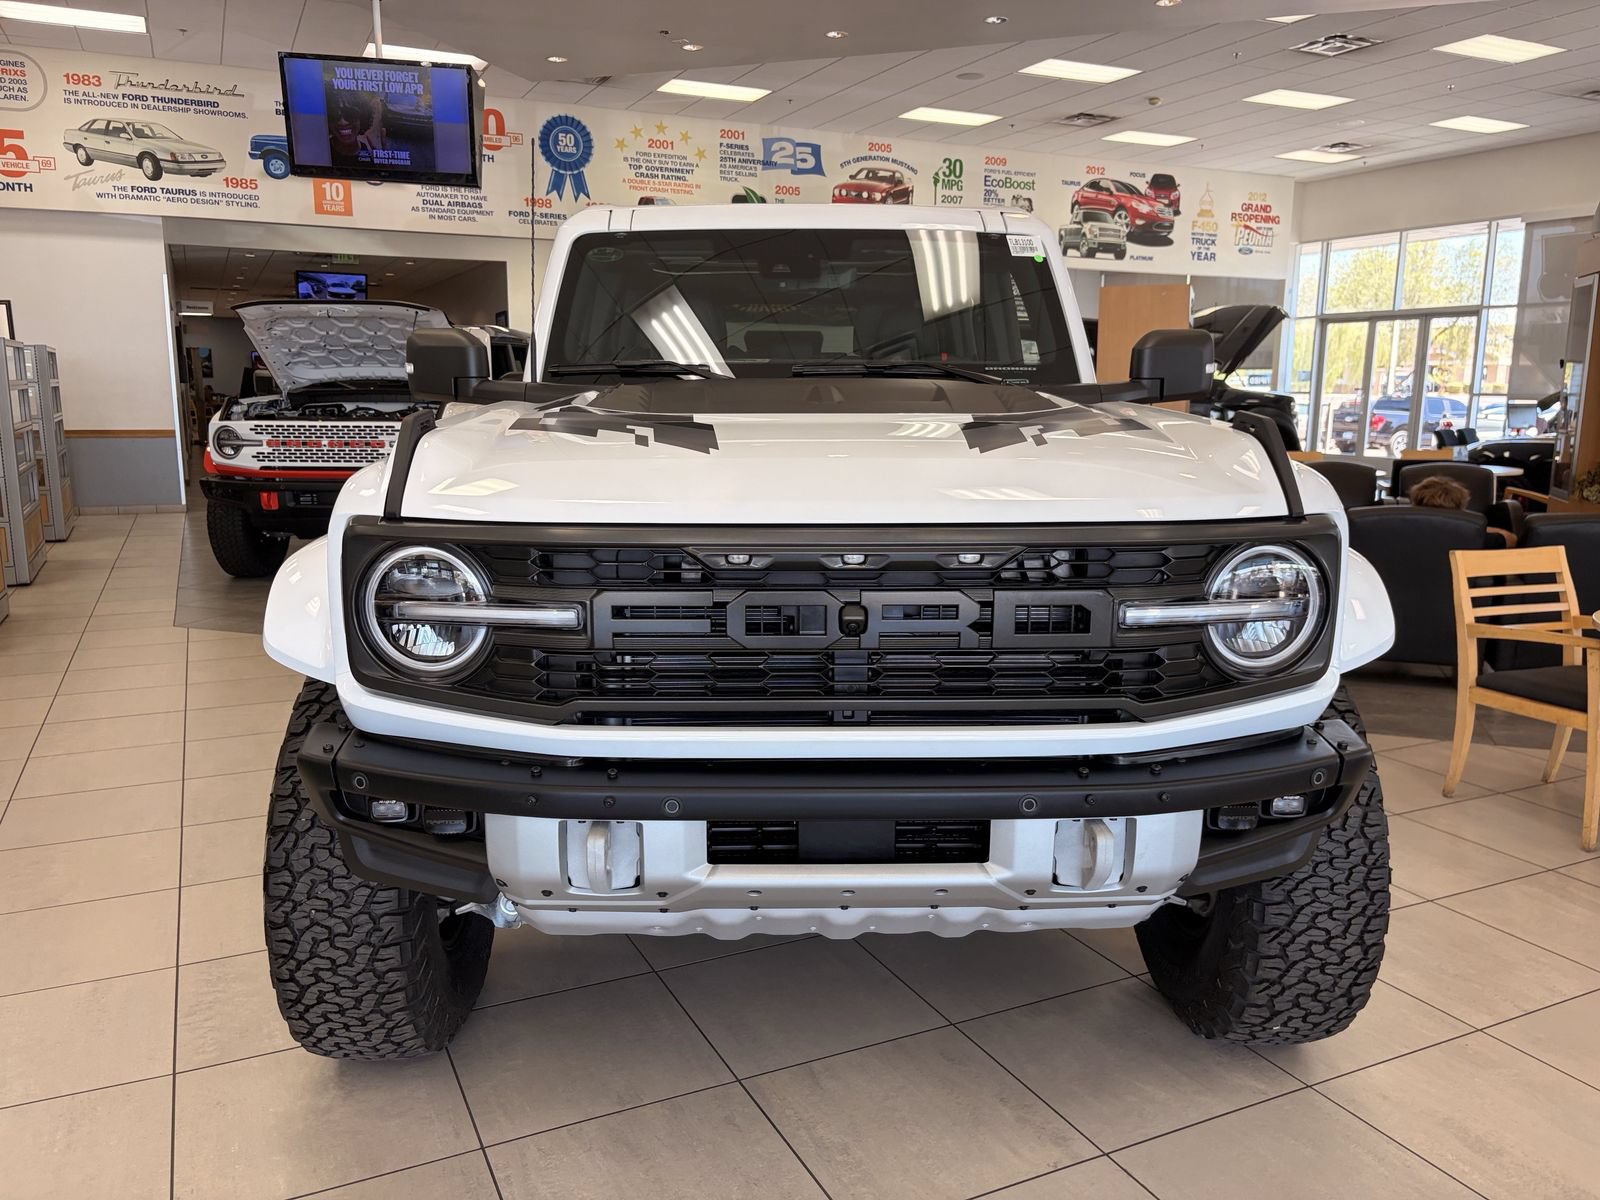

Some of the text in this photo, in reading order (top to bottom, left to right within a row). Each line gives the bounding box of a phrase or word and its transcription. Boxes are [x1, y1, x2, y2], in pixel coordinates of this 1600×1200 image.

[1, 68, 26, 77] RIXS
[334, 66, 418, 83] YOU NEVER FORGET
[8, 78, 27, 86] 2003
[63, 72, 102, 87] 1983
[108, 70, 245, 98] Thunderbird
[332, 78, 424, 95] YOUR FIRST LOW APR
[82, 91, 119, 100] ALL-NEW
[122, 93, 149, 102] FORD
[151, 96, 220, 108] THUNDERBIRD
[74, 98, 128, 108] INTRODUCED
[141, 104, 191, 113] DEALERSHIP
[194, 108, 248, 119] SHOWROOMS.
[558, 133, 576, 147] 50
[720, 129, 745, 140] 2001
[556, 145, 577, 154] YEARS
[648, 138, 674, 150] 2001
[720, 142, 750, 150] F-SERIES
[868, 142, 892, 153] 2005
[372, 150, 410, 160] FIRST-TIME
[654, 152, 688, 160] EXPEDITION
[720, 150, 755, 158] CELEBRATES
[770, 141, 816, 169] 25
[2, 161, 30, 170] VEHICLE
[720, 156, 778, 167] 25TH ANIVERSARY
[840, 156, 918, 175] 5TH GENERATION MUSTANG
[984, 156, 1006, 166] 2009
[645, 164, 695, 175] GOVERNMENT
[735, 170, 758, 178] SELLING
[942, 158, 964, 179] 30
[1086, 166, 1106, 176] 2012
[64, 169, 126, 192] Taurus
[628, 178, 651, 186] DOUBLE
[634, 172, 688, 182] CRASH RATING.
[984, 175, 1036, 190] EcoBoost
[222, 176, 258, 190] 1985
[942, 178, 964, 191] MPG
[130, 186, 157, 194] FORD
[160, 187, 198, 196] TAURUS
[208, 192, 260, 201] INTRODUCED
[321, 182, 344, 201] 10
[450, 186, 462, 194] THE
[775, 185, 800, 196] 2005
[983, 189, 999, 198] 20%
[119, 193, 161, 202] DRAMATIC
[226, 200, 260, 208] STYLING.
[416, 192, 459, 200] AUTOMAKER
[941, 194, 964, 204] 2007
[1248, 192, 1267, 202] 2012
[322, 204, 345, 212] YEARS
[447, 201, 483, 209] AIRBAGS
[524, 197, 552, 208] 1998
[1241, 202, 1272, 214] GRAND
[421, 206, 456, 214] STANDARD
[508, 210, 530, 218] FORD
[438, 214, 456, 222] MOST
[518, 218, 558, 226] CELBRATES
[1230, 212, 1280, 225] REOPENING
[1192, 220, 1218, 232] F-150
[1191, 237, 1216, 246] TRUCK
[1190, 250, 1216, 262] YEAR
[594, 589, 1113, 649] FORD
